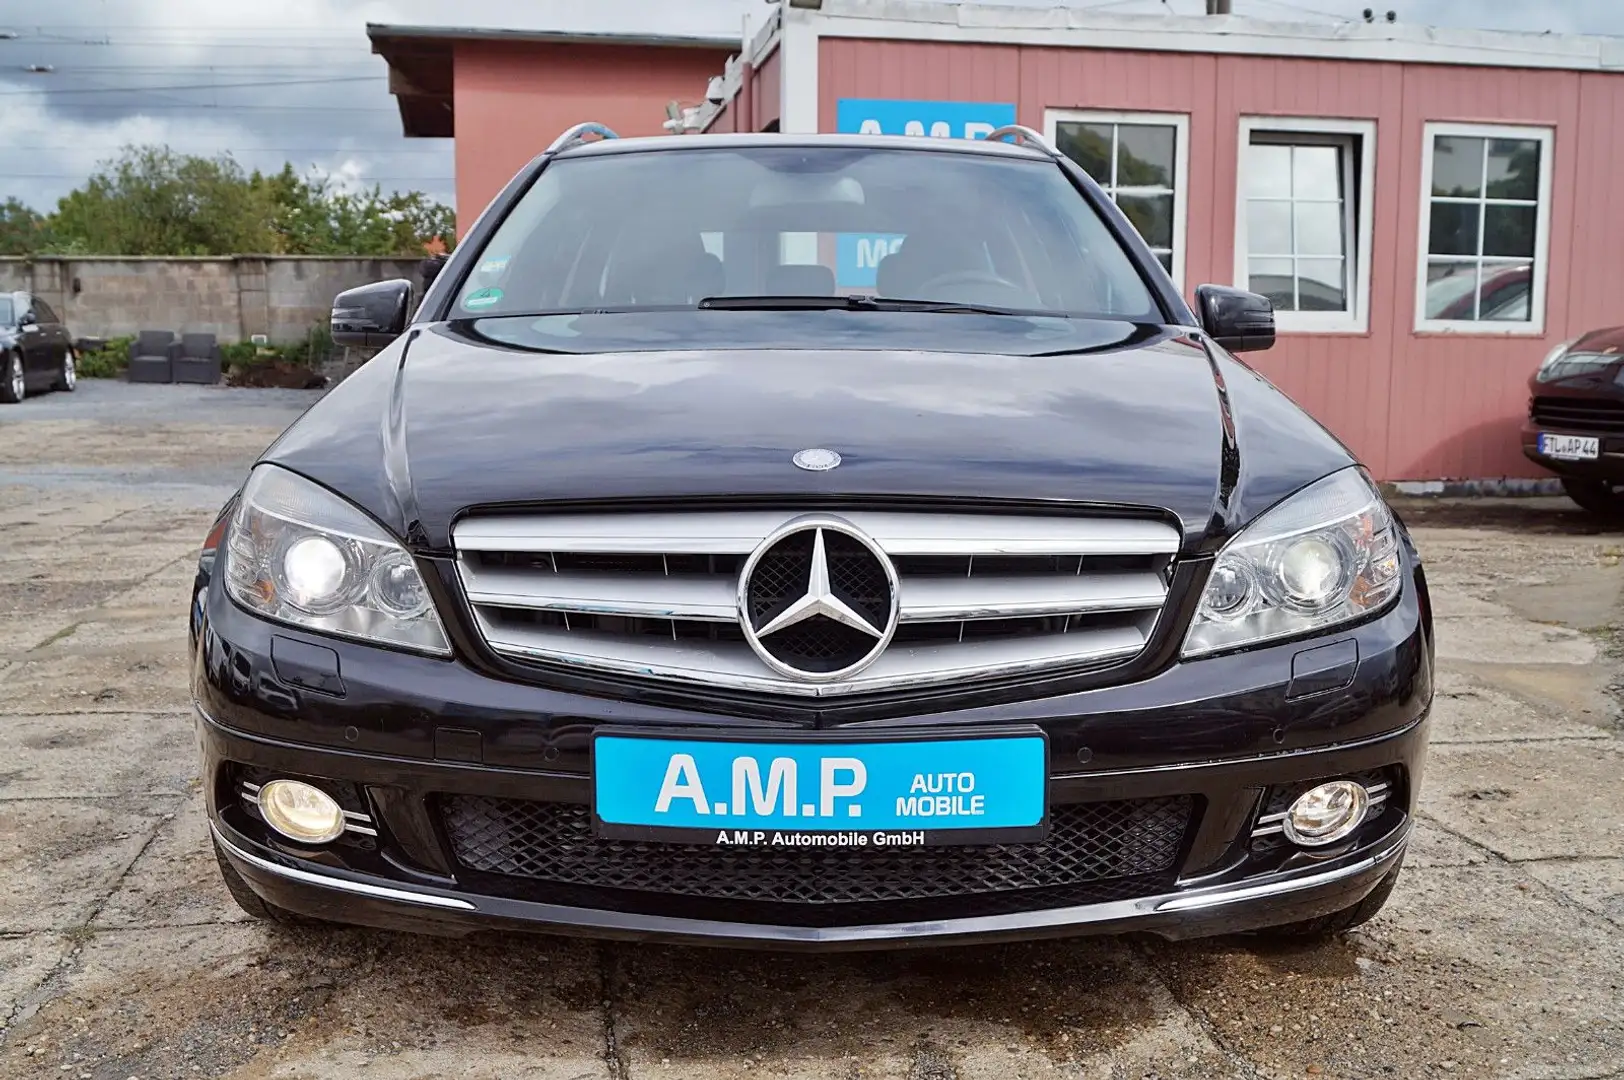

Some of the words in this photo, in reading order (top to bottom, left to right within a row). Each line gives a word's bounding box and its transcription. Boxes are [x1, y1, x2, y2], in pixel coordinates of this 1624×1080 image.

[1582, 440, 1596, 455] 44
[654, 753, 867, 818] A.M.P.
[910, 772, 975, 793] AUTO
[896, 795, 985, 816] MOBILE
[716, 831, 768, 845] A.M.P.
[772, 831, 868, 847] Automobile
[873, 831, 925, 846] GmbH
